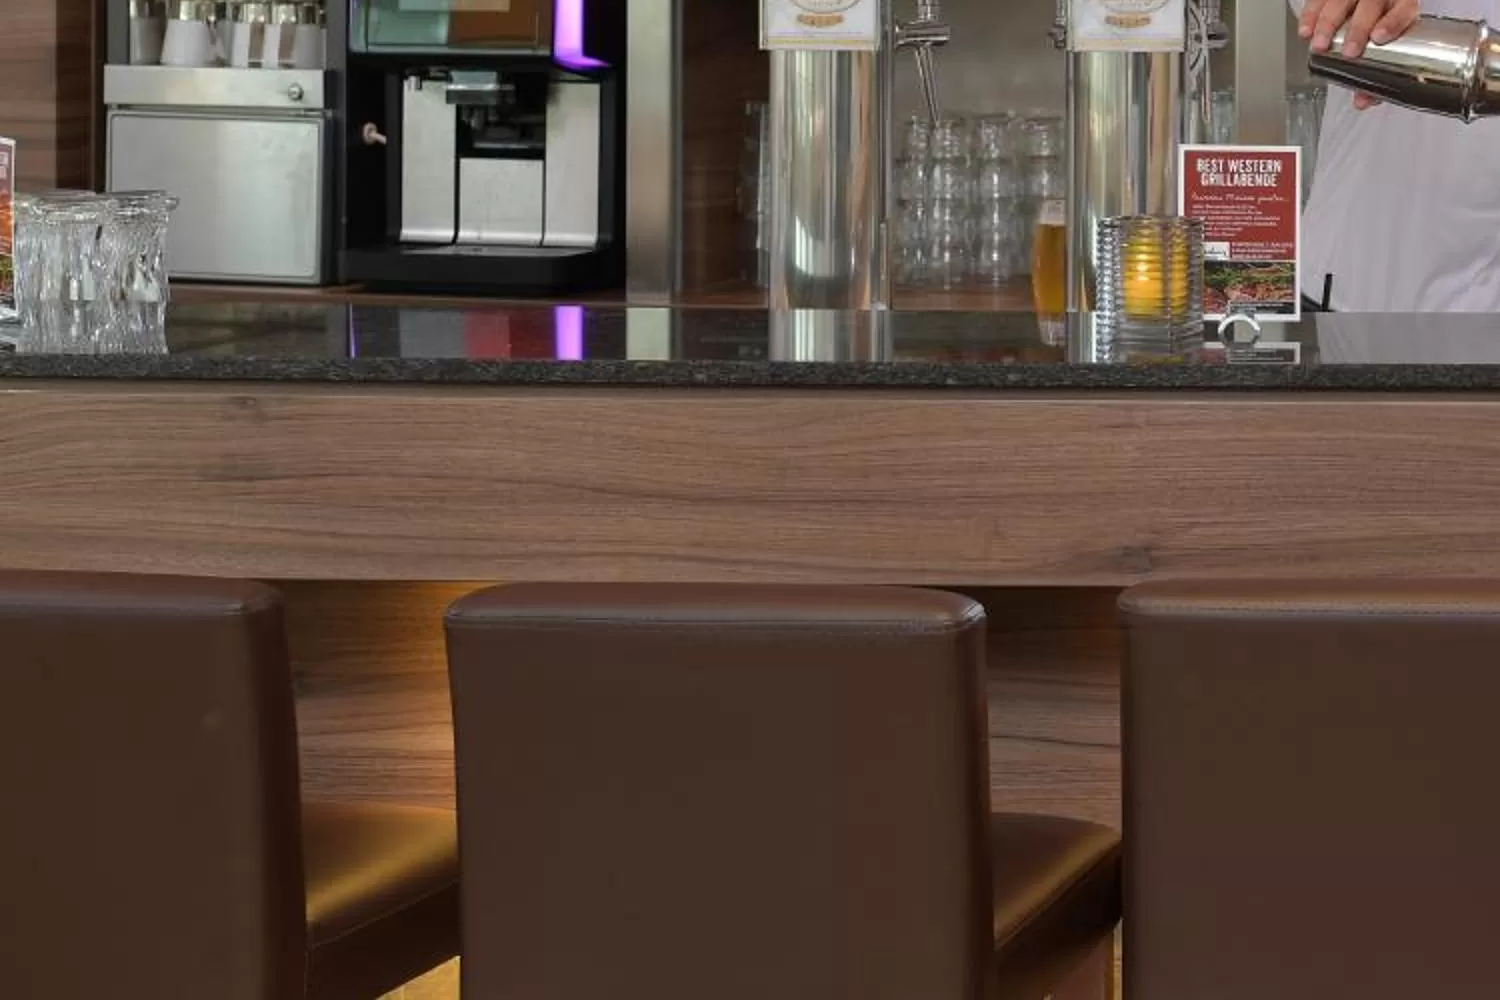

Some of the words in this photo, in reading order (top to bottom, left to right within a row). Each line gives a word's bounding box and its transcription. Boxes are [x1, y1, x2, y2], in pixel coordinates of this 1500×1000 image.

[1196, 159, 1224, 172] BEST
[1228, 159, 1283, 173] WESTERN
[1201, 173, 1278, 187] GRILLABENDE
